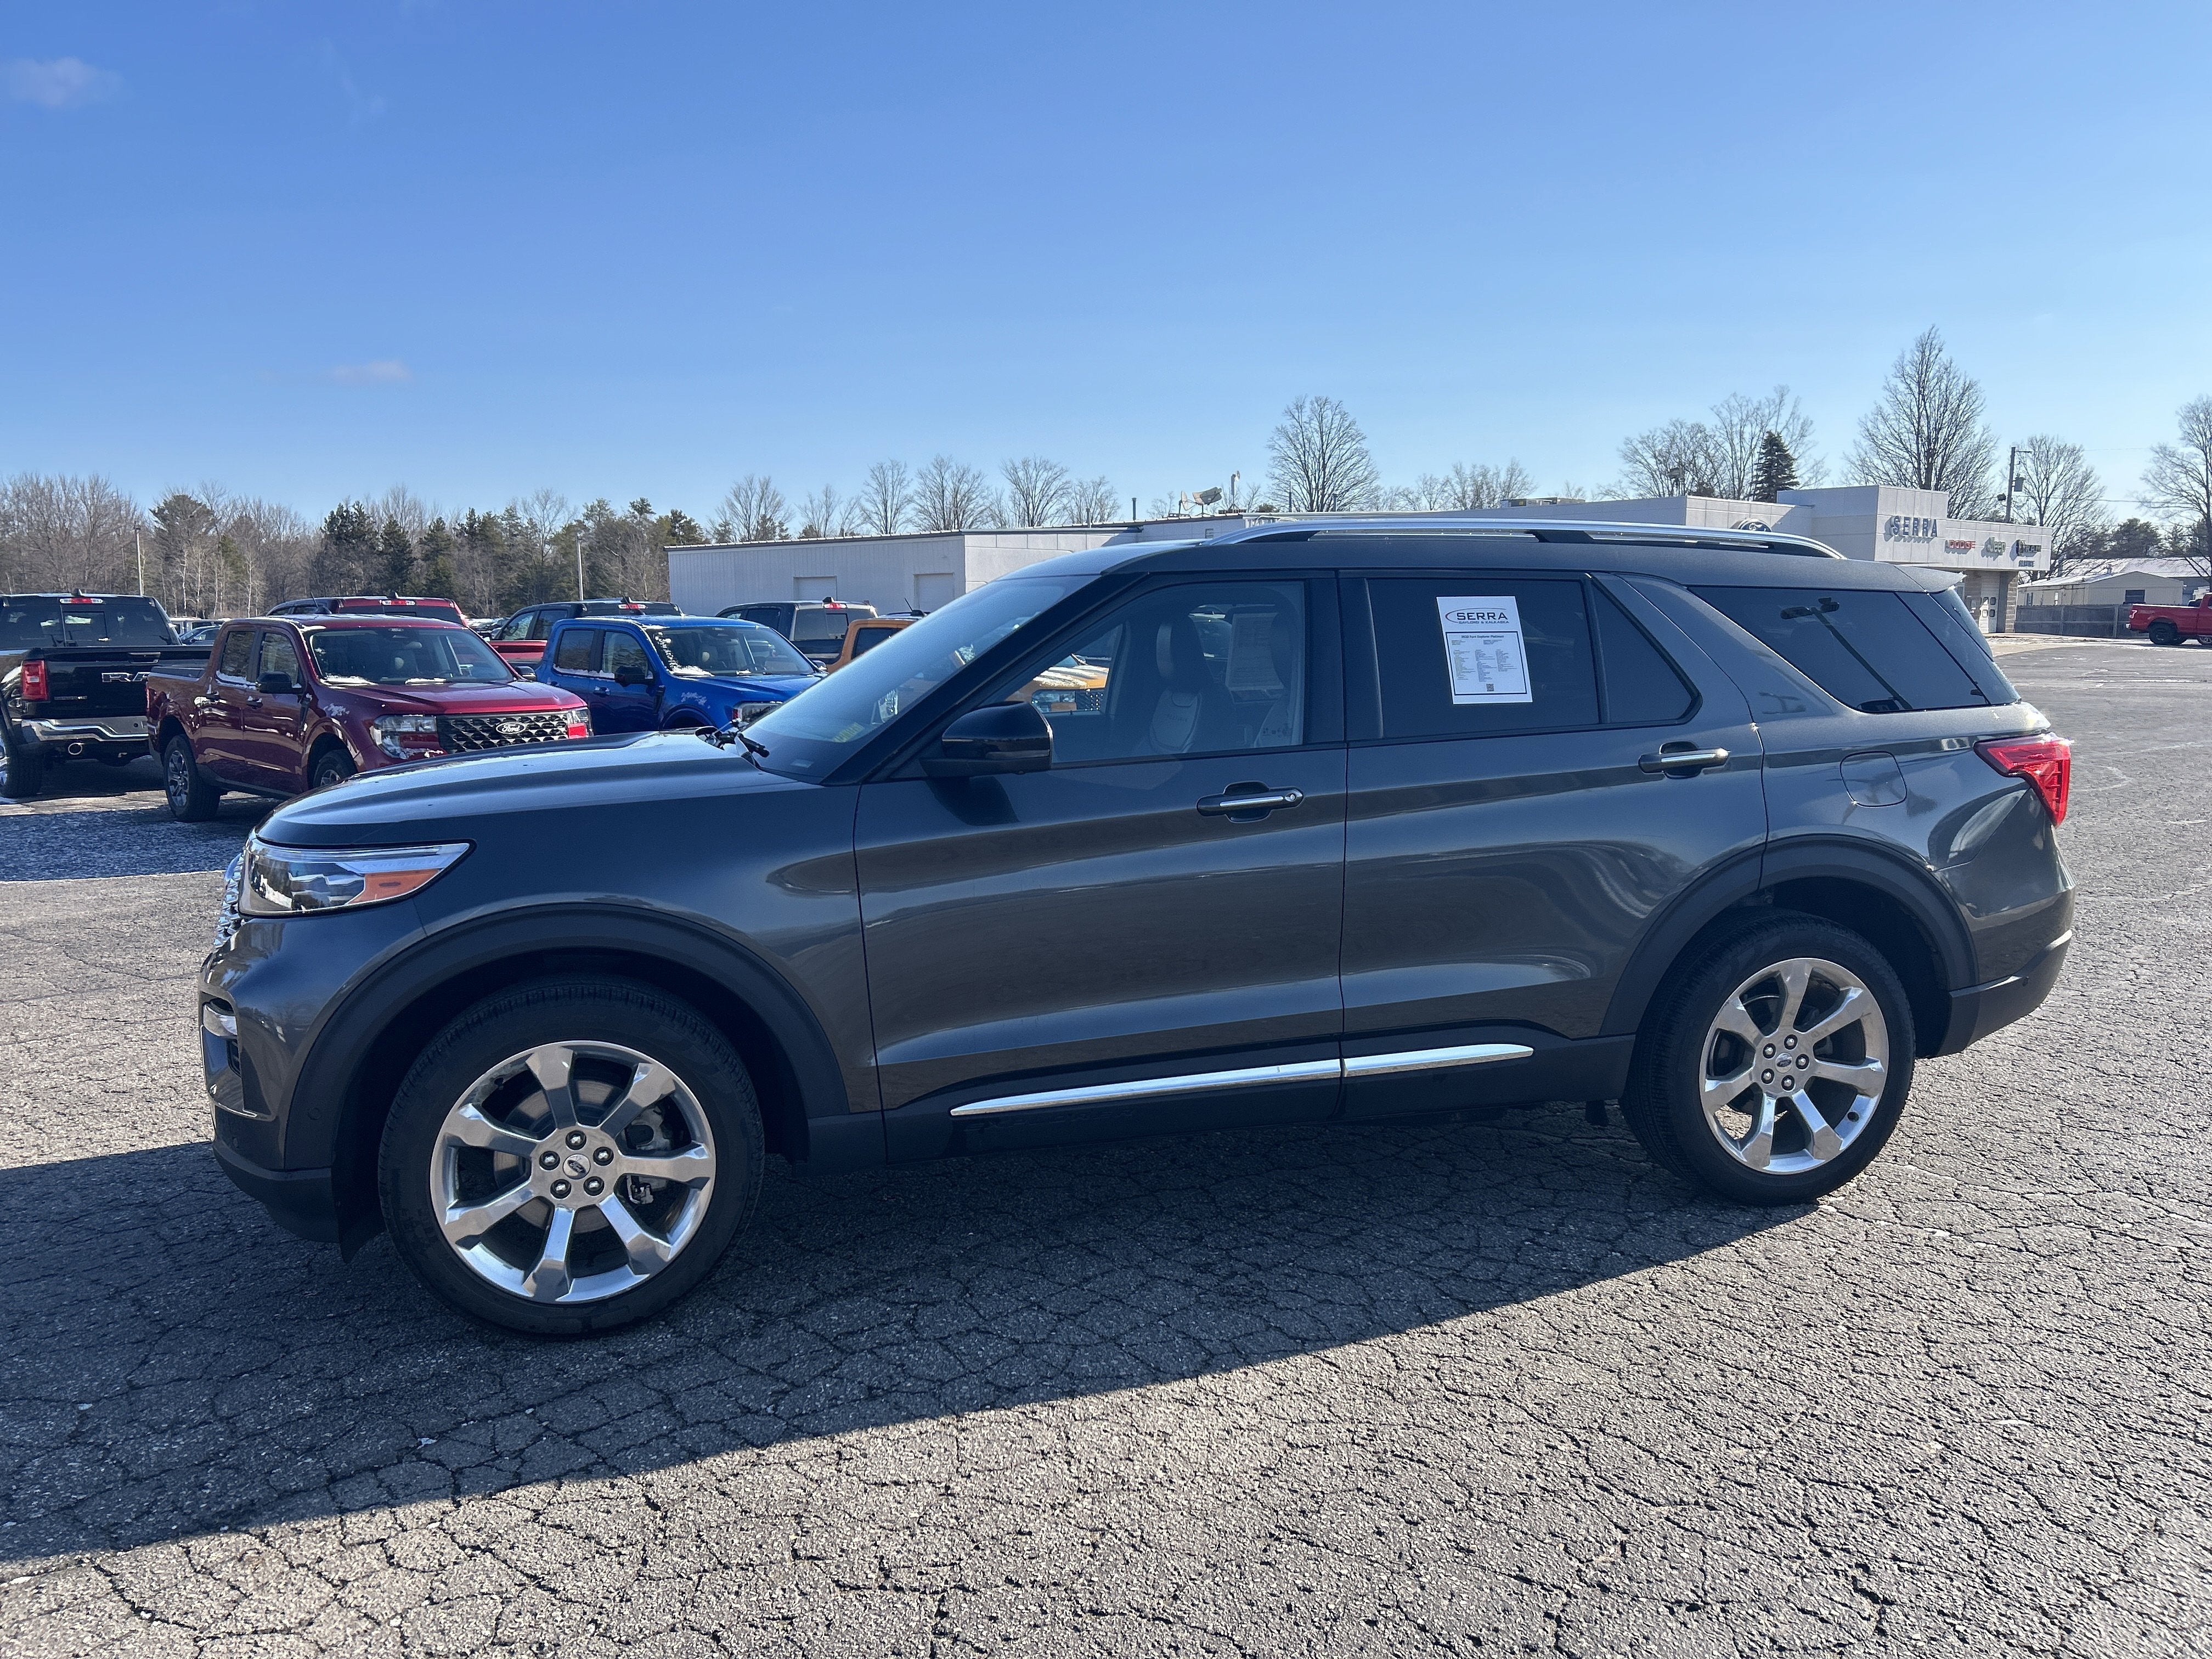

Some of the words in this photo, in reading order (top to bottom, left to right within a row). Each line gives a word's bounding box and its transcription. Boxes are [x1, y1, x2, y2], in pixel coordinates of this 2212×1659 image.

[1893, 516, 1937, 537] SERRA
[1949, 540, 1976, 549] DODGE
[1986, 537, 2006, 556] Jeep
[101, 672, 150, 682] RA
[500, 723, 522, 733] Ford
